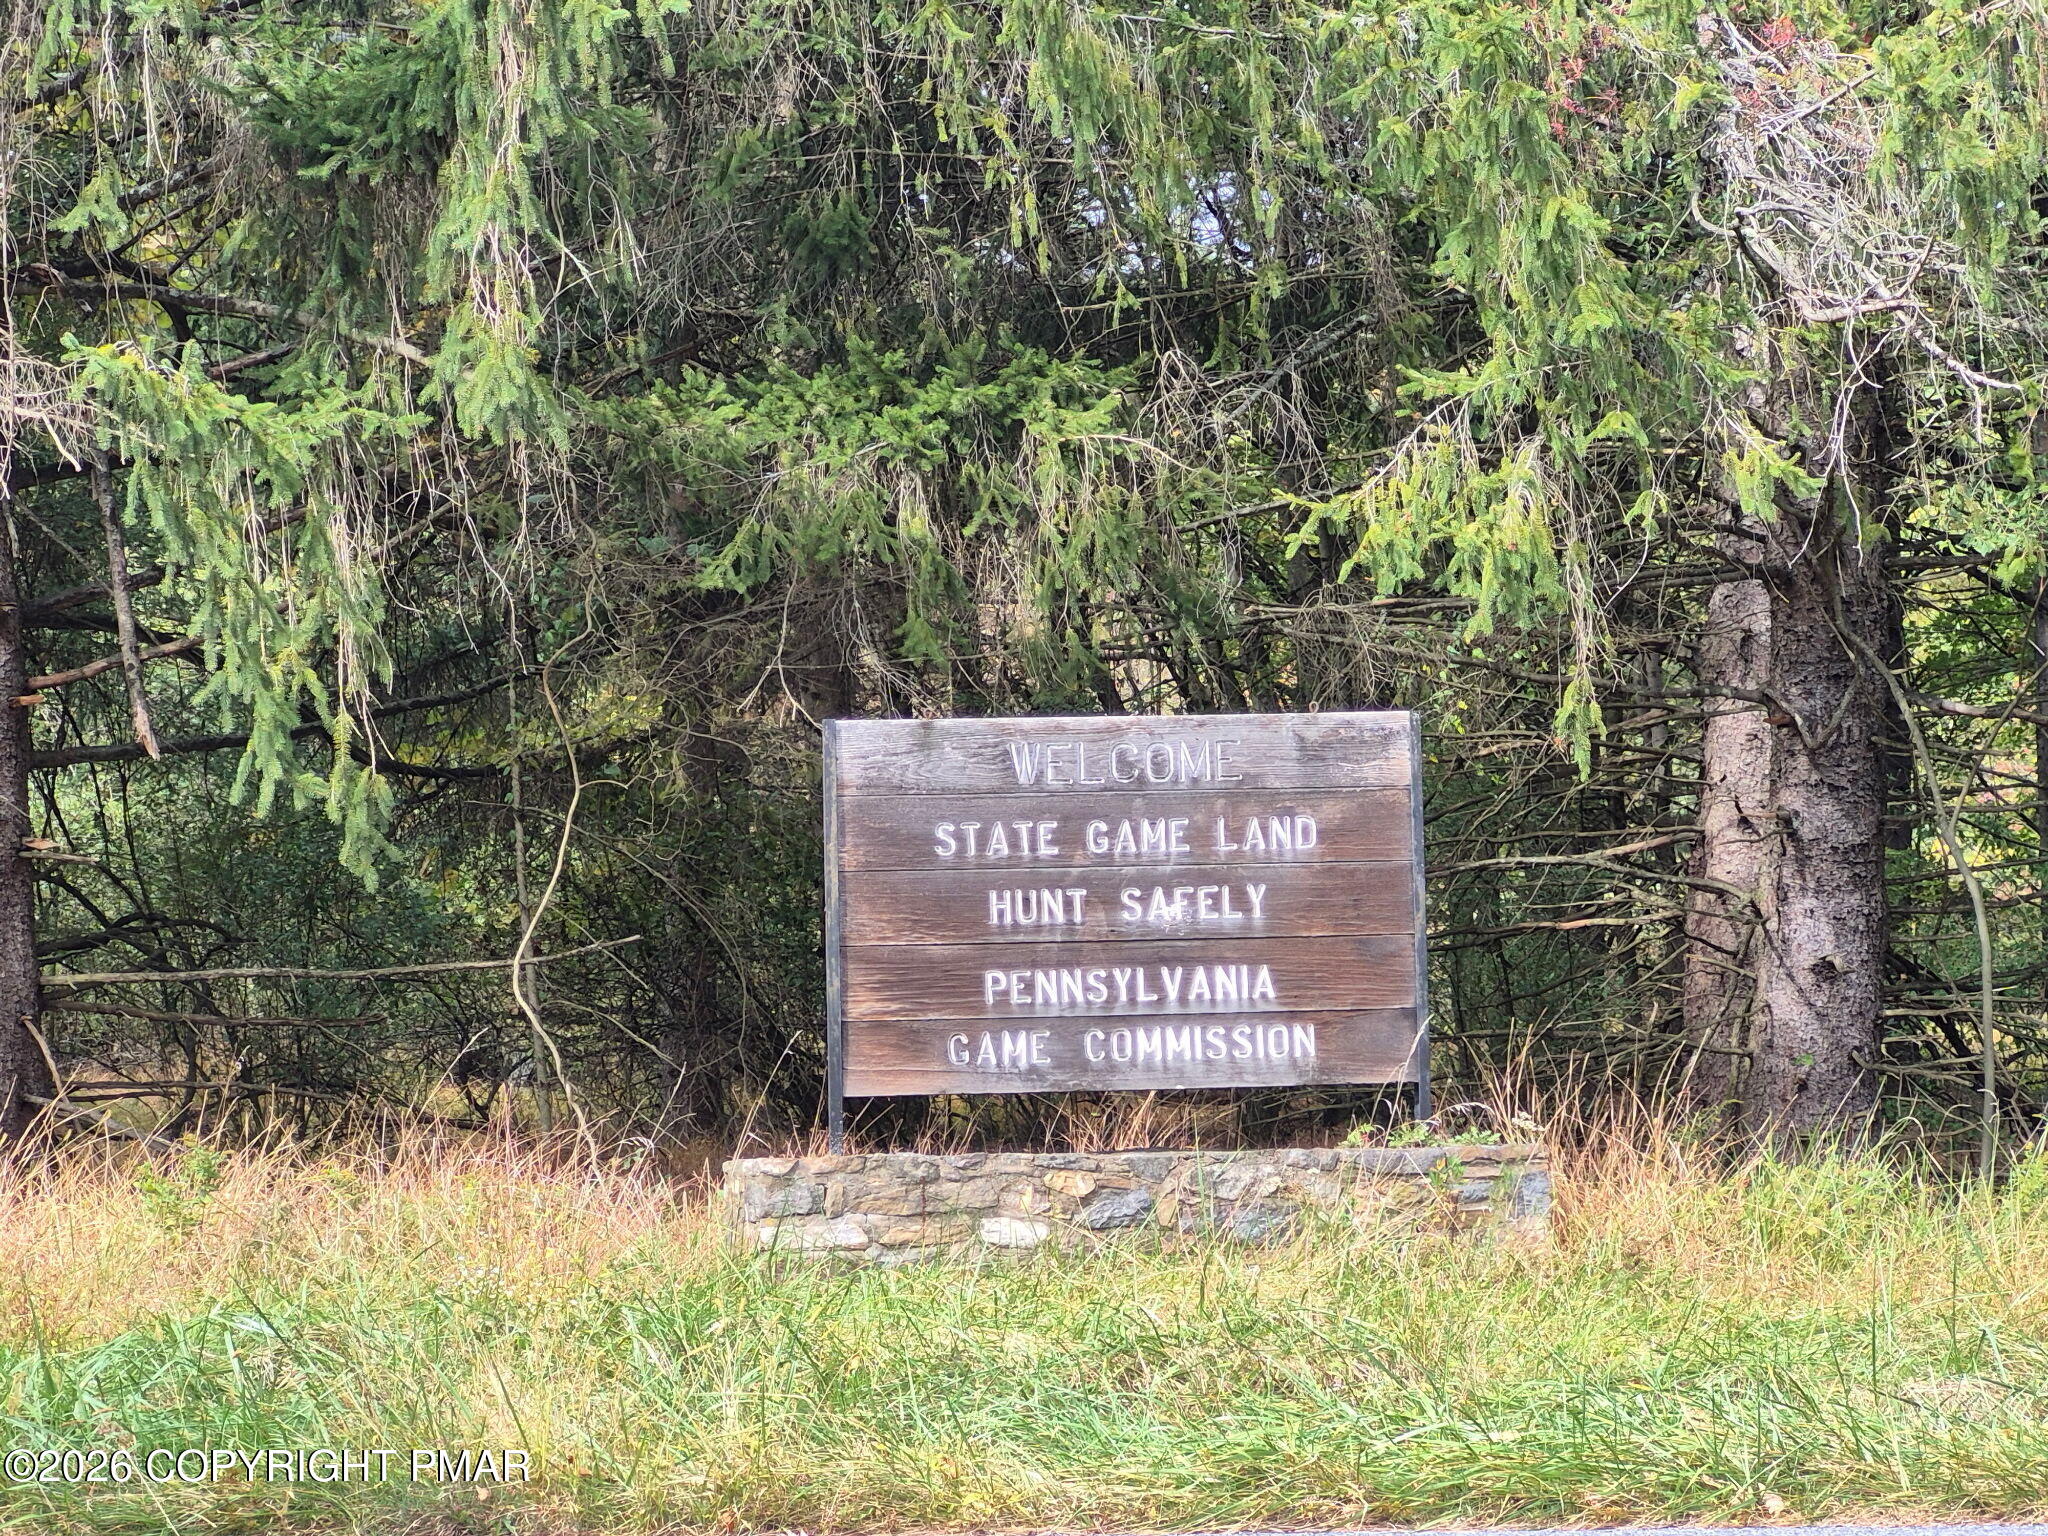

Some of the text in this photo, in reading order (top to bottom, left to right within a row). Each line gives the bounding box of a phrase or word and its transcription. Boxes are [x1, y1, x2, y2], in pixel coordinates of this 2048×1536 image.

[1010, 740, 1243, 785] WELCOME
[934, 815, 1318, 857] STATE GAME LAND
[989, 884, 1267, 925] HUNT SAFELY
[985, 965, 1276, 1004] PENNSYLVANIA
[947, 1024, 1317, 1066] GAME COMMISSION
